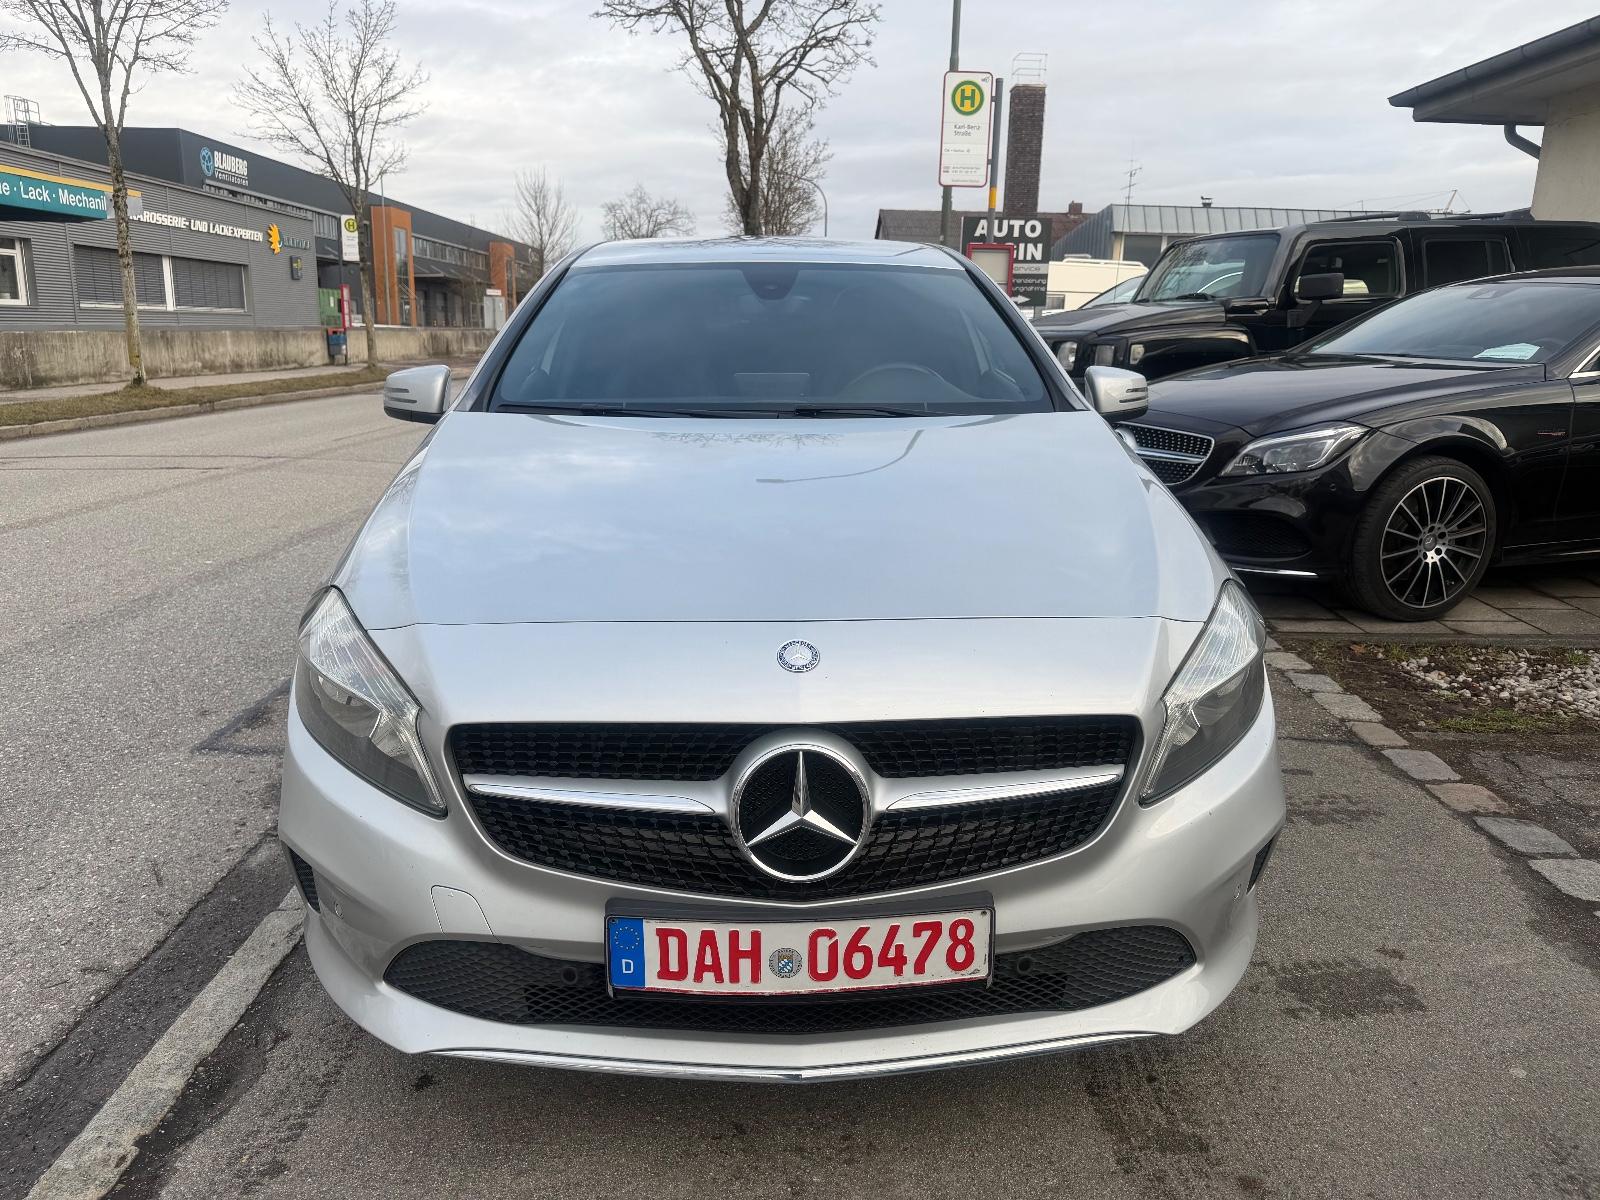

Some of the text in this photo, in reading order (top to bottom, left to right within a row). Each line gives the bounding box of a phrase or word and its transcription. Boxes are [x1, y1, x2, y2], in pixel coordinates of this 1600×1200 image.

[960, 88, 976, 108] H
[214, 150, 248, 177] BLAUBERG
[214, 169, 249, 187] Ventilatoren
[19, 181, 51, 202] Lack
[190, 219, 208, 233] UND
[209, 222, 263, 242] LACKEXPERTEN
[974, 219, 1042, 238] AUTO
[655, 927, 762, 984] DAH
[807, 918, 976, 982] 06478
[621, 958, 634, 974] D
